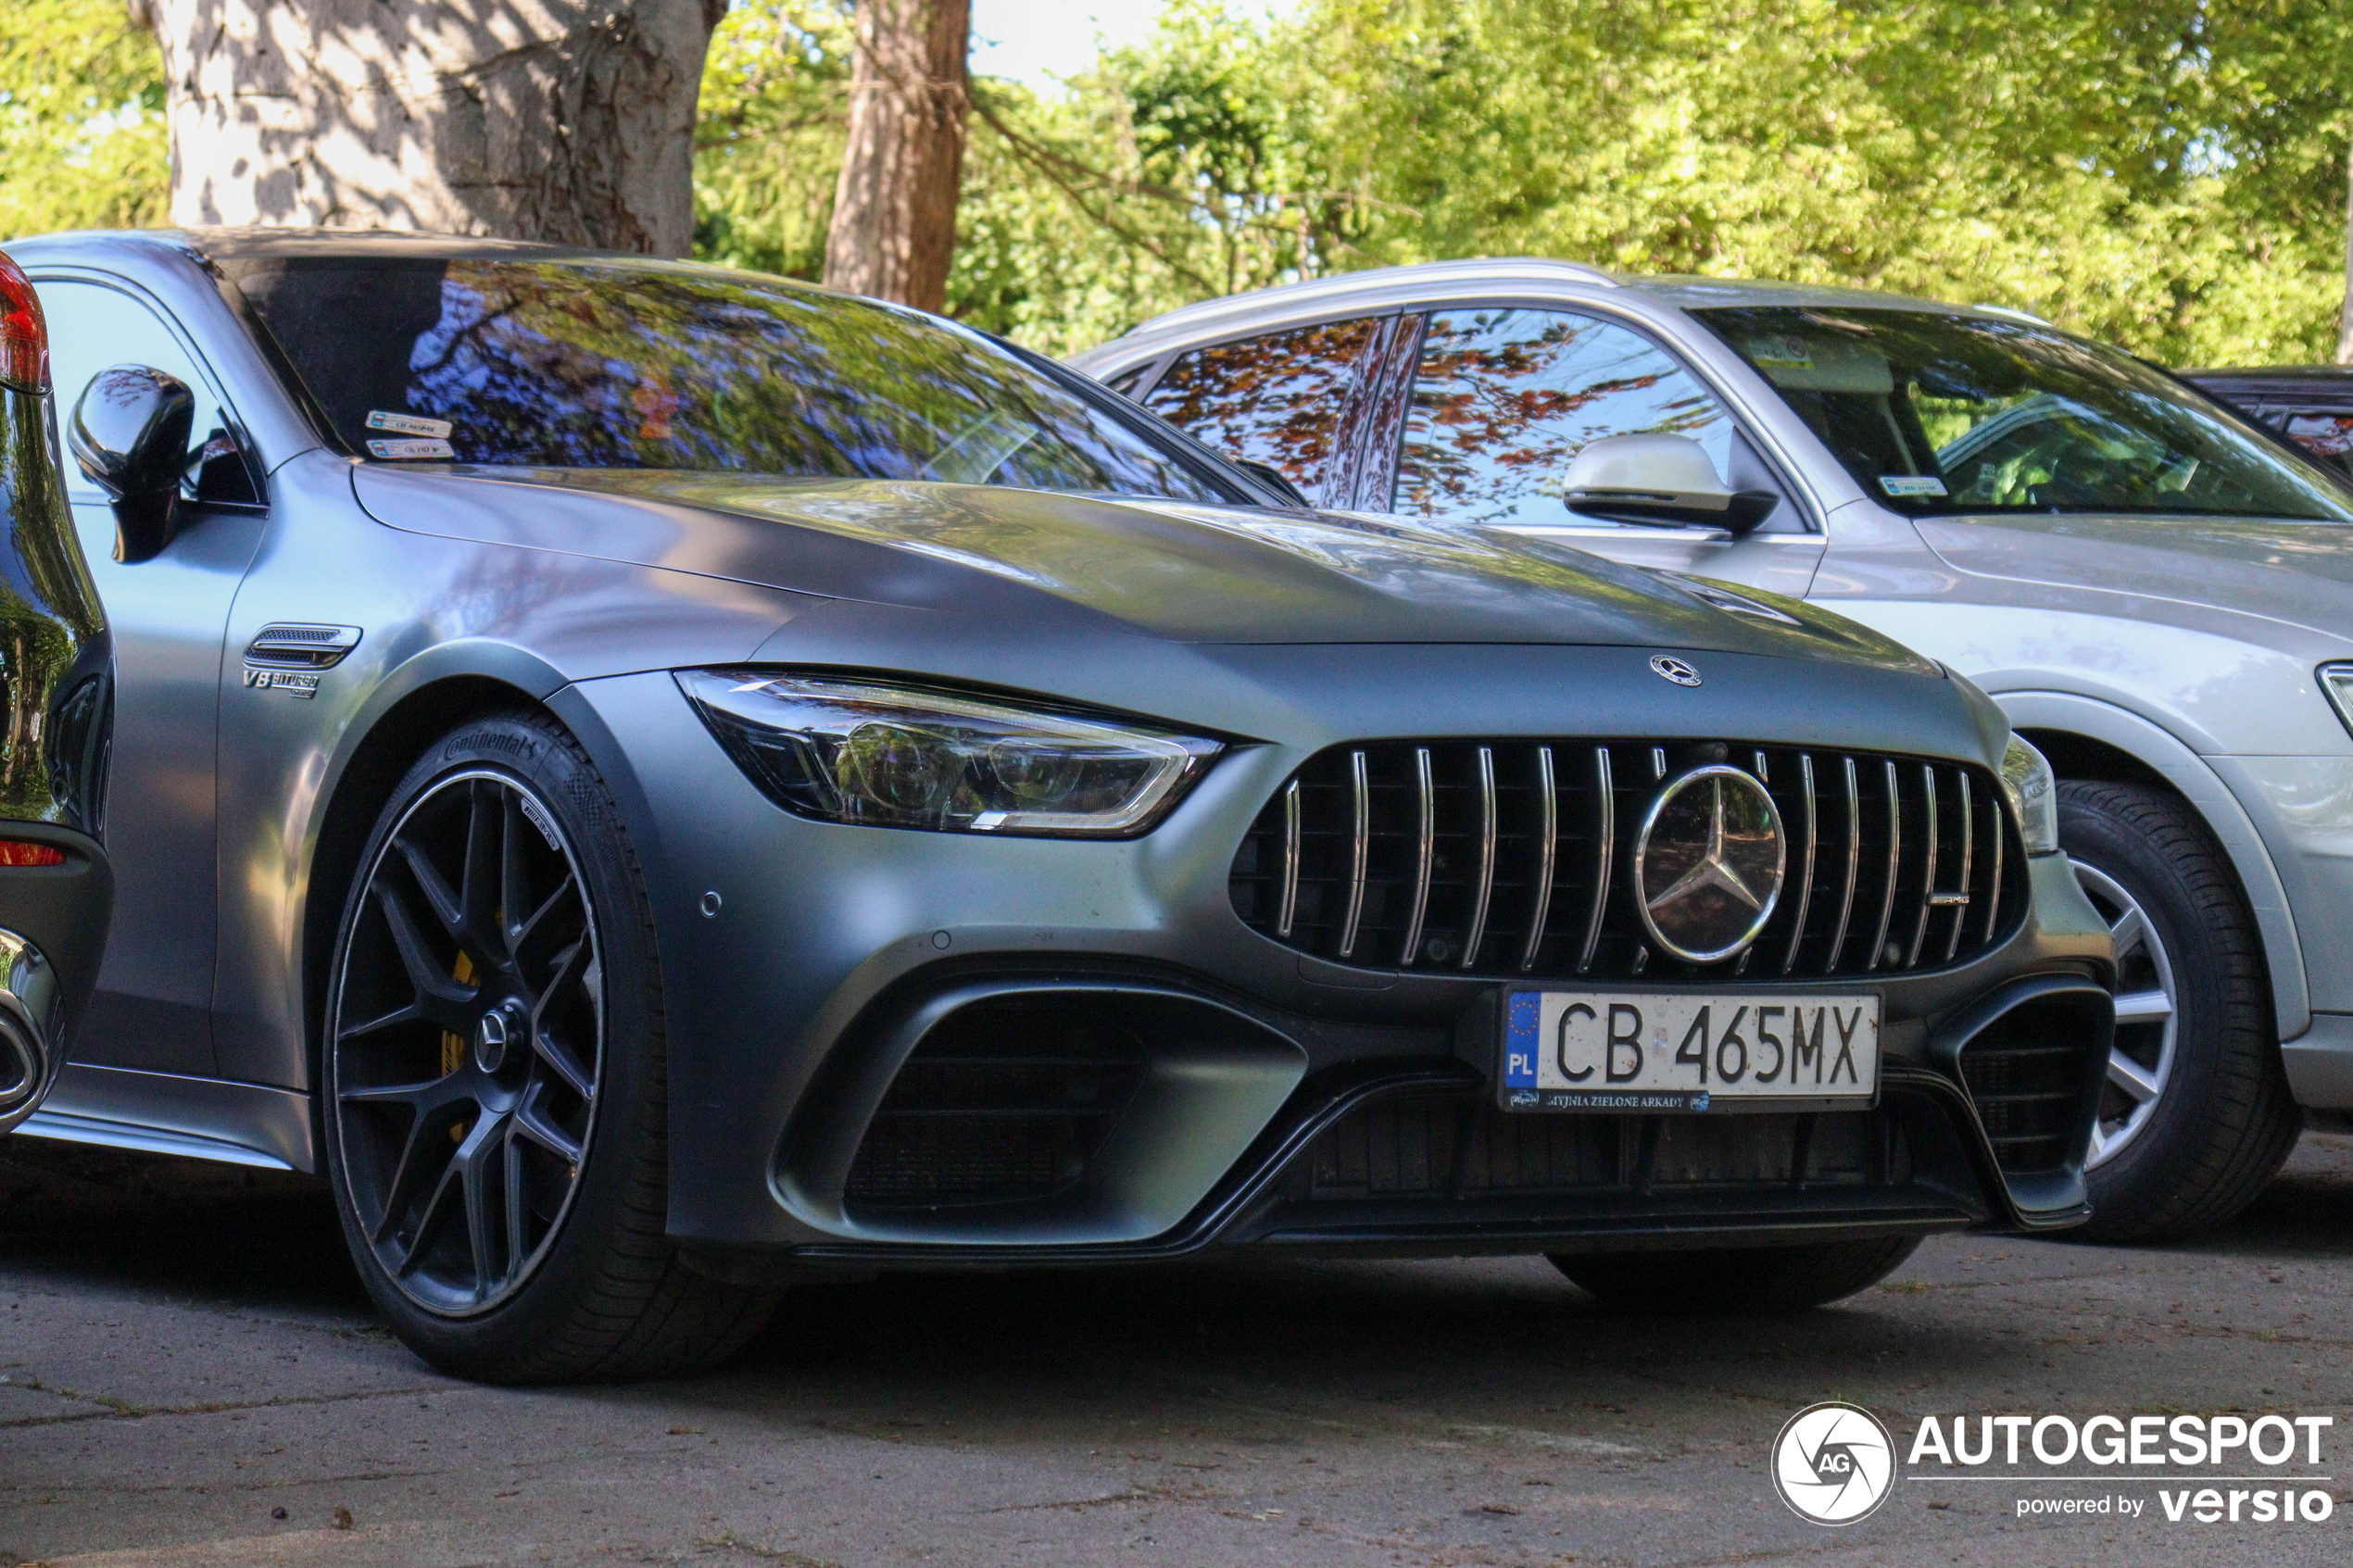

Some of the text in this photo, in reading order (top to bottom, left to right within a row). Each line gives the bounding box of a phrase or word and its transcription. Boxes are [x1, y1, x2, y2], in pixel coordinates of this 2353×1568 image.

[243, 670, 319, 688] V8 BITURBO
[445, 730, 528, 760] Continental
[532, 815, 556, 847] AMG
[1944, 896, 1970, 904] AMG
[1557, 1002, 1863, 1084] CB 465MX
[1508, 1053, 1533, 1075] PL
[1591, 1097, 1639, 1108] ZIELONE
[1641, 1097, 1684, 1108] ARKADY
